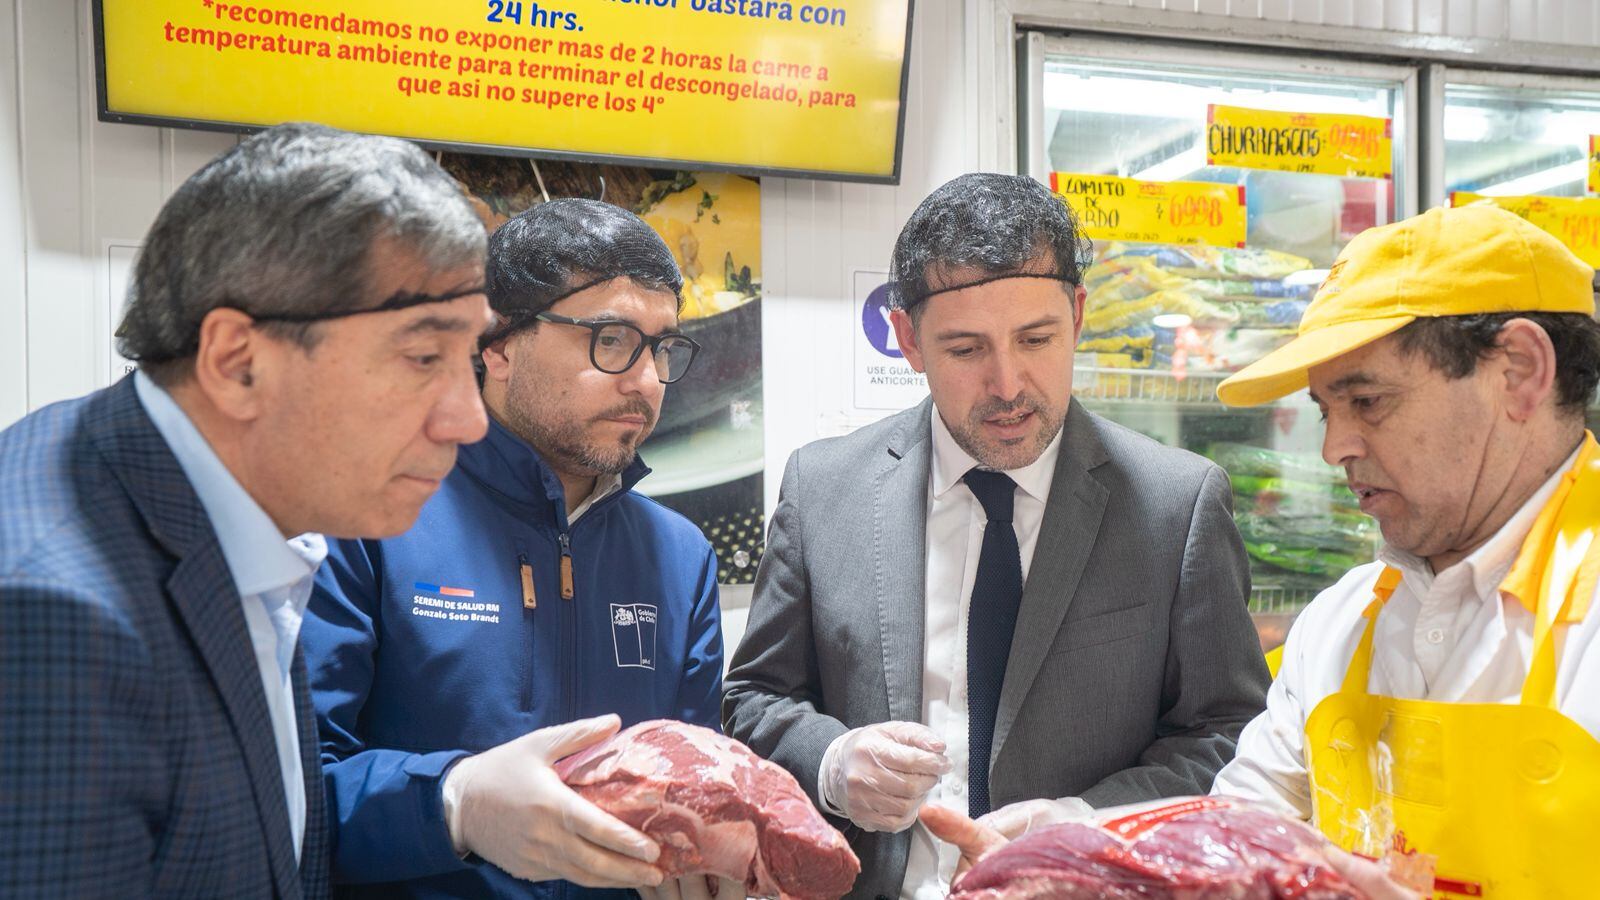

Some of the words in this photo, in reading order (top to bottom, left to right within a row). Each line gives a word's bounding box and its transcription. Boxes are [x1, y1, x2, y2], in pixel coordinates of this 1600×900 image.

[487, 0, 522, 25] 24
[531, 3, 584, 32] hrs.
[799, 5, 847, 26] con
[418, 25, 449, 43] no
[455, 29, 553, 54] exponer
[558, 41, 604, 59] mas
[609, 43, 636, 62] de
[641, 45, 655, 64] 2
[660, 47, 722, 71] horas
[728, 54, 747, 73] la
[752, 60, 812, 80] carne
[817, 66, 829, 81] a
[164, 21, 331, 58] temperatura
[337, 43, 452, 69] ambiente
[457, 56, 512, 76] para
[518, 58, 620, 86] terminar
[625, 69, 644, 88] el
[650, 72, 803, 106] descongelado,
[808, 89, 857, 108] para
[397, 76, 442, 96] que
[447, 79, 480, 98] asi
[486, 84, 515, 102] no
[521, 88, 599, 109] supere
[604, 92, 636, 112] los
[641, 95, 665, 114] 4°
[1065, 178, 1125, 197] LOMITO
[1080, 207, 1120, 229] RDO
[1169, 194, 1223, 228] 6998
[866, 366, 886, 375] USE
[889, 366, 917, 376] GUAN
[870, 376, 926, 386] ANTICORTE
[413, 595, 444, 608] SEREMI
[444, 600, 456, 610] DE
[456, 601, 485, 612] SALUD
[485, 603, 500, 613] RM
[412, 607, 447, 619] Gonzalo
[470, 613, 500, 624] Brandt
